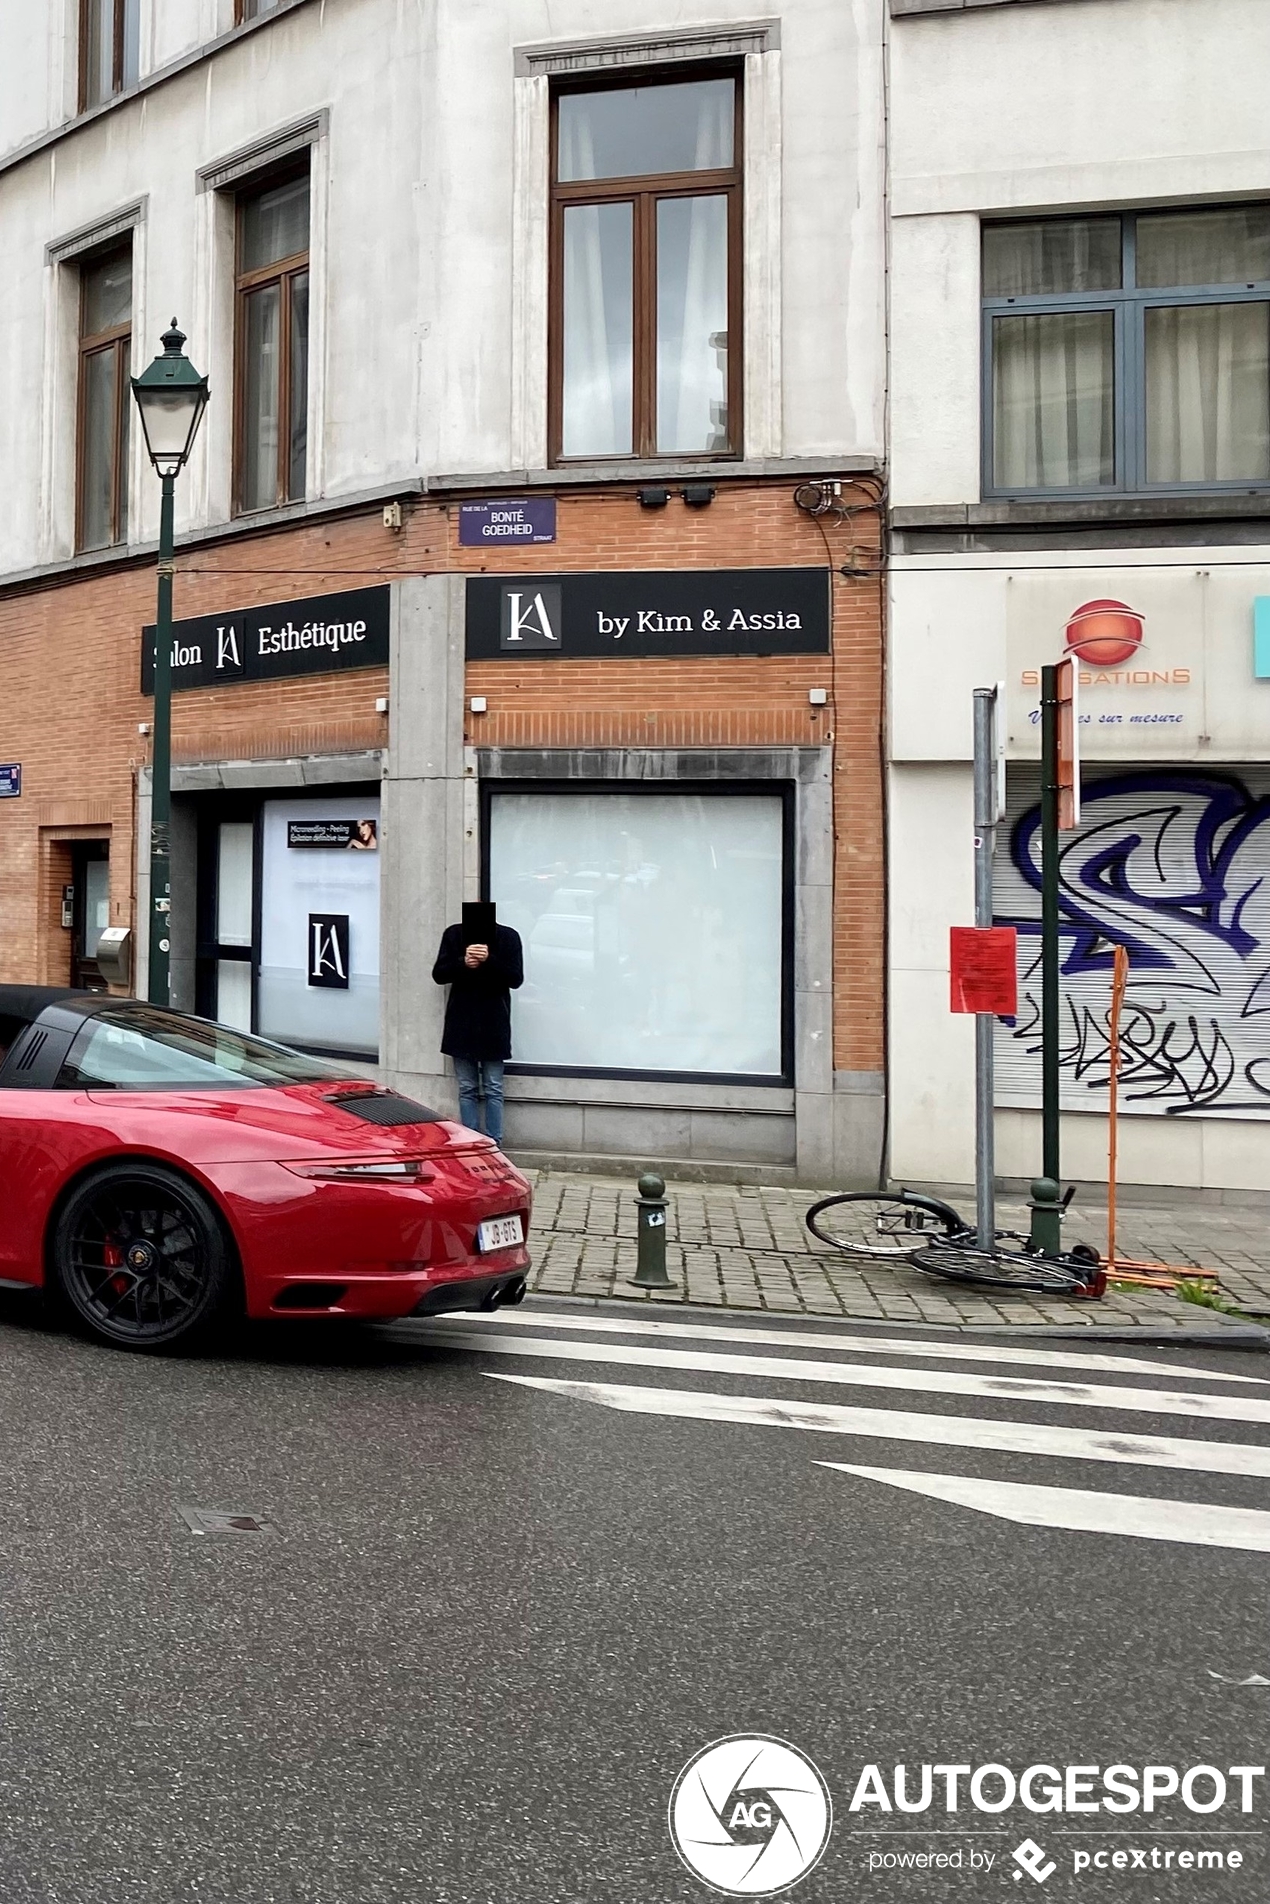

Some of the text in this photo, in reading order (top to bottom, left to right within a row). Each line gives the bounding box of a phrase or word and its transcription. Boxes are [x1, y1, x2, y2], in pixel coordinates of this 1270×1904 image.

[491, 509, 524, 523] BONTÉ
[482, 524, 533, 536] GOEDHEID
[596, 611, 630, 639] by
[637, 610, 693, 633] Kim
[701, 609, 721, 631] &
[727, 609, 802, 632] Assia
[258, 620, 367, 655] Esthétique
[1021, 669, 1191, 686] SSATIONS
[1098, 714, 1123, 724] sur
[1130, 714, 1184, 724] mesure
[330, 824, 350, 834] Peeling
